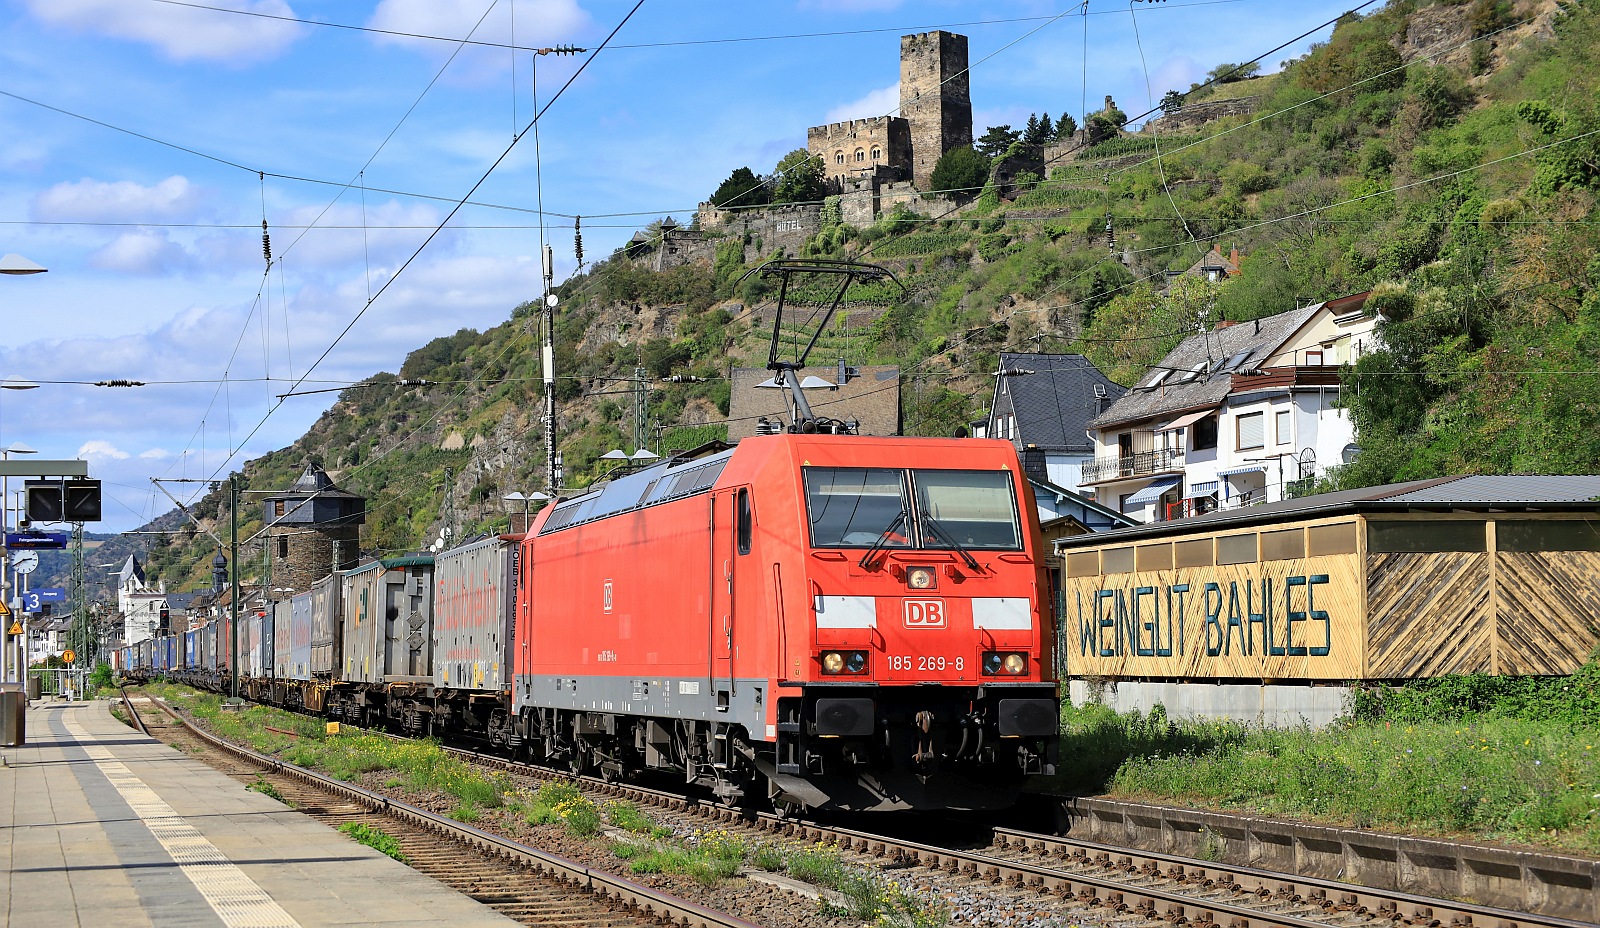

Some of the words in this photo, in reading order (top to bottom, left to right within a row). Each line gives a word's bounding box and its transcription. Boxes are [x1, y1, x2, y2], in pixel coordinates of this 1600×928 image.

[776, 219, 802, 232] HOTEL
[29, 593, 40, 609] 3
[908, 602, 942, 624] DB
[1076, 583, 1189, 657] WEINGUT
[1204, 573, 1331, 657] BAHLES
[887, 655, 912, 671] 185
[917, 655, 965, 671] 269-8
